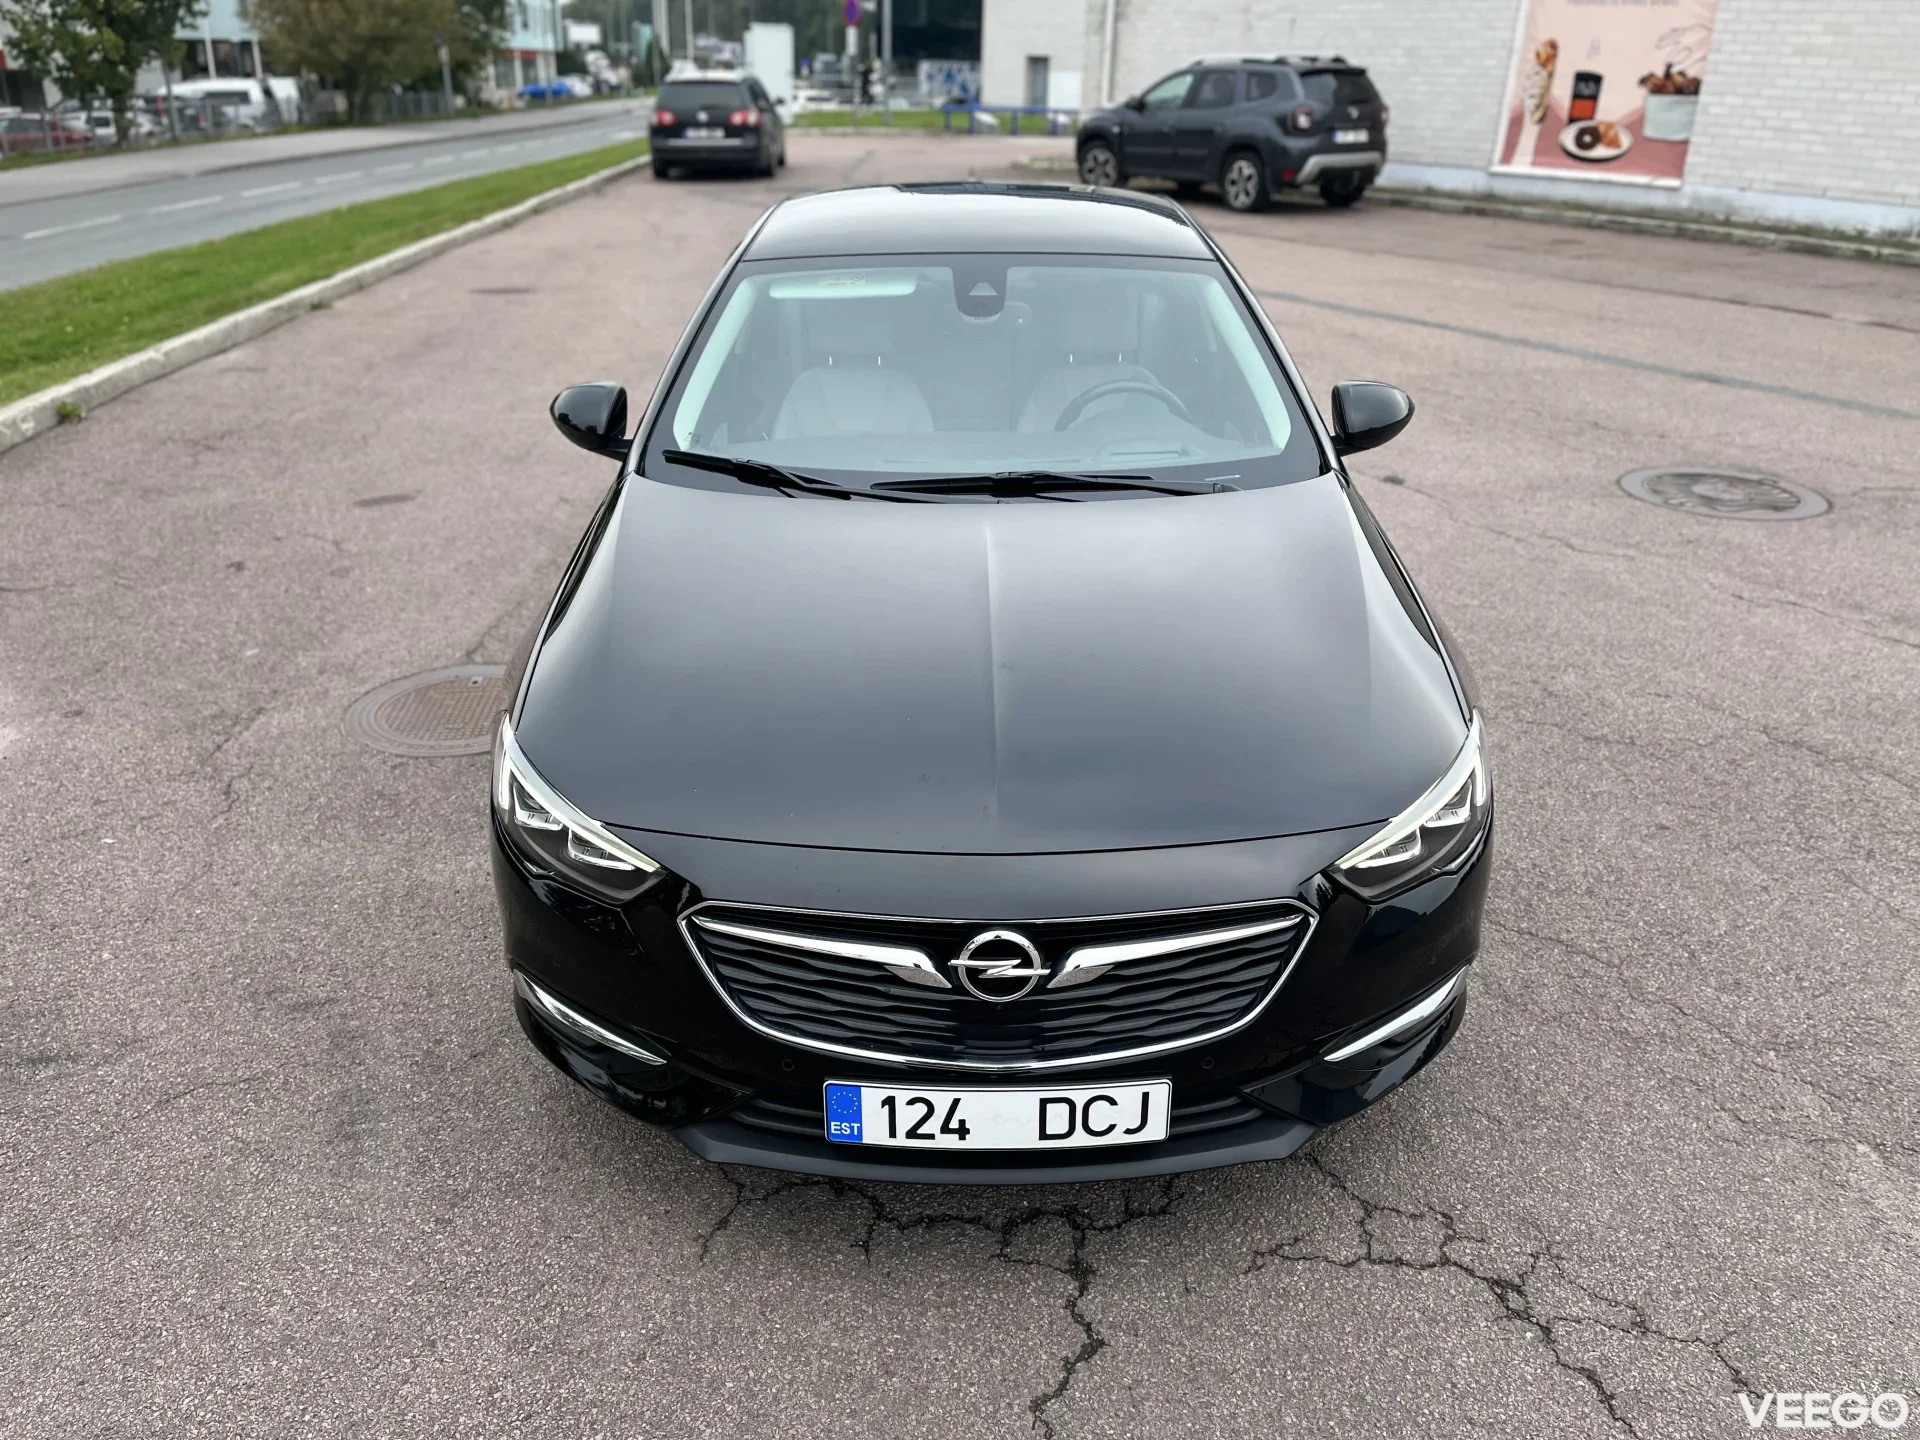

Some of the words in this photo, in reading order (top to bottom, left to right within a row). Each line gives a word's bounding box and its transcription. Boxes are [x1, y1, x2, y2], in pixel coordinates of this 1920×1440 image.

[830, 1121, 861, 1137] EST
[880, 1094, 971, 1141] 124
[1038, 1091, 1150, 1142] DCJ
